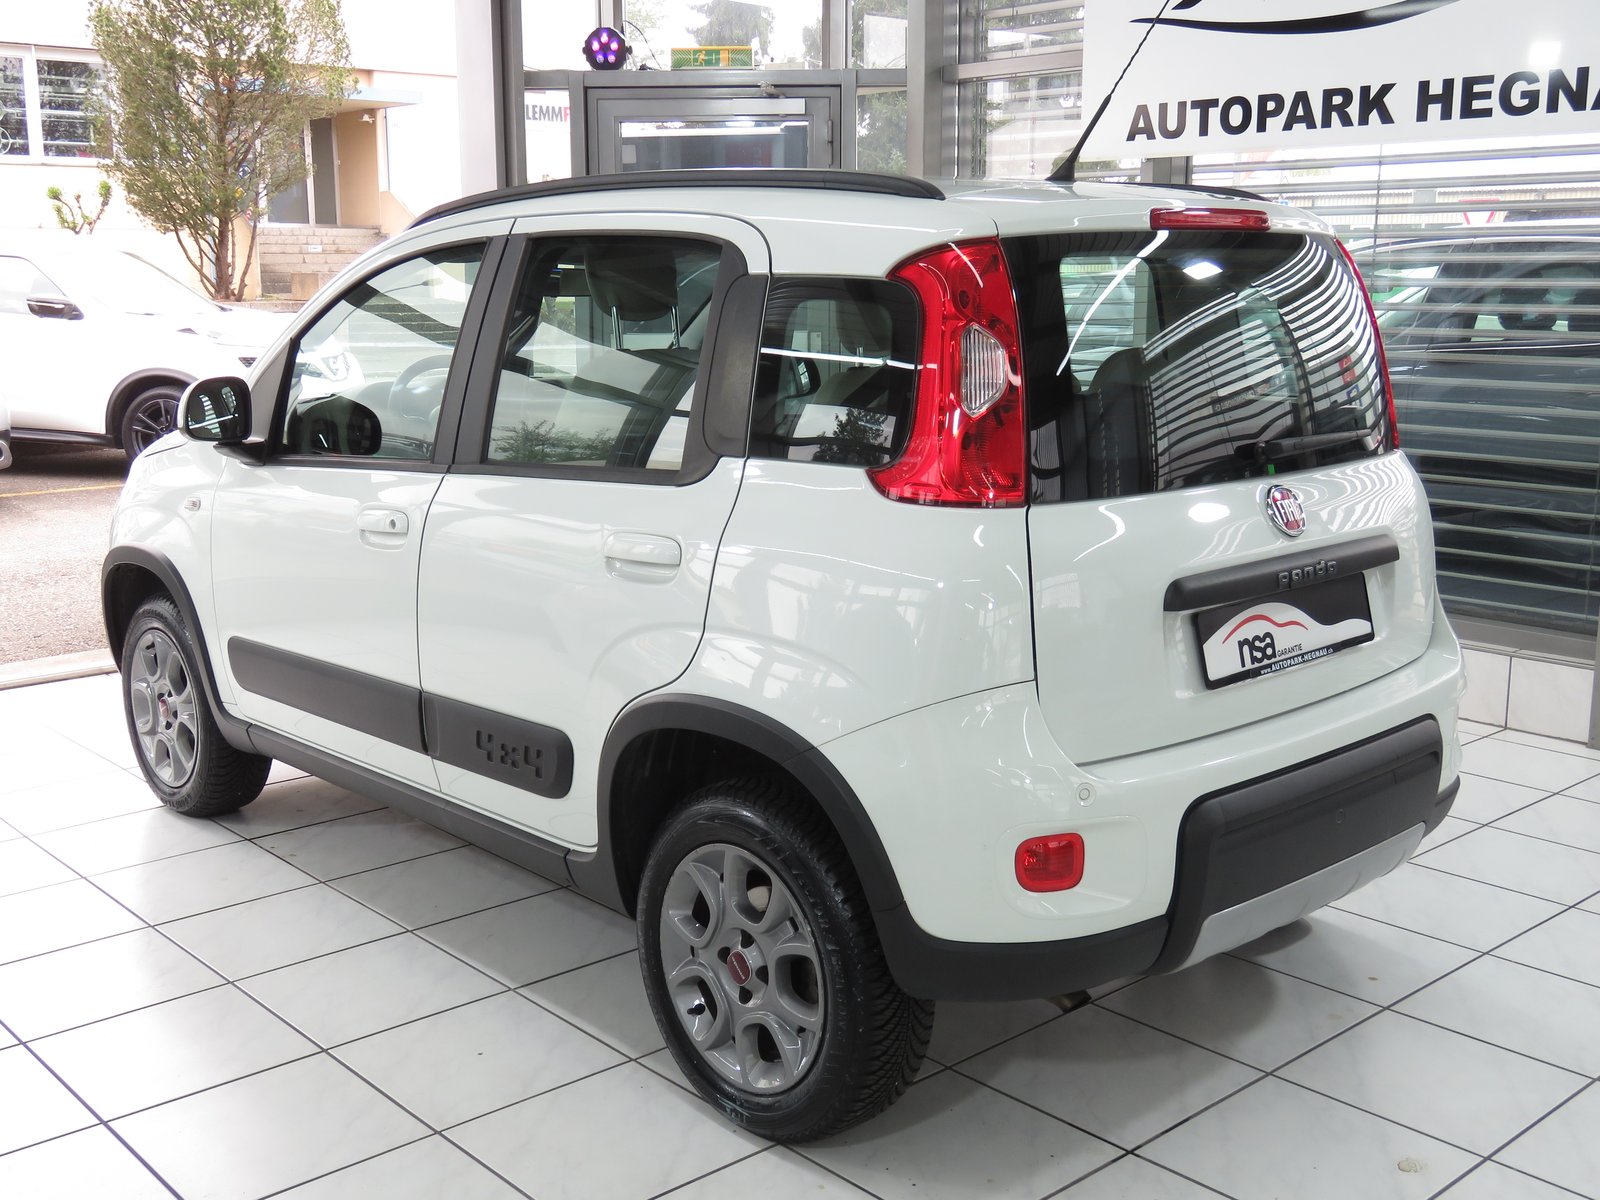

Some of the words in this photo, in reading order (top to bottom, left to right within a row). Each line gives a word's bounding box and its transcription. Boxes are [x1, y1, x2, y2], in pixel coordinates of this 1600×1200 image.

[1126, 82, 1397, 142] AUTOPARK
[1416, 66, 1600, 122] HEGN
[1237, 632, 1276, 668] nsa
[1277, 643, 1303, 658] GARANTIE
[1260, 648, 1334, 675] www.AUTOPARK-HEGNAU.ch
[476, 729, 543, 779] 4x4
